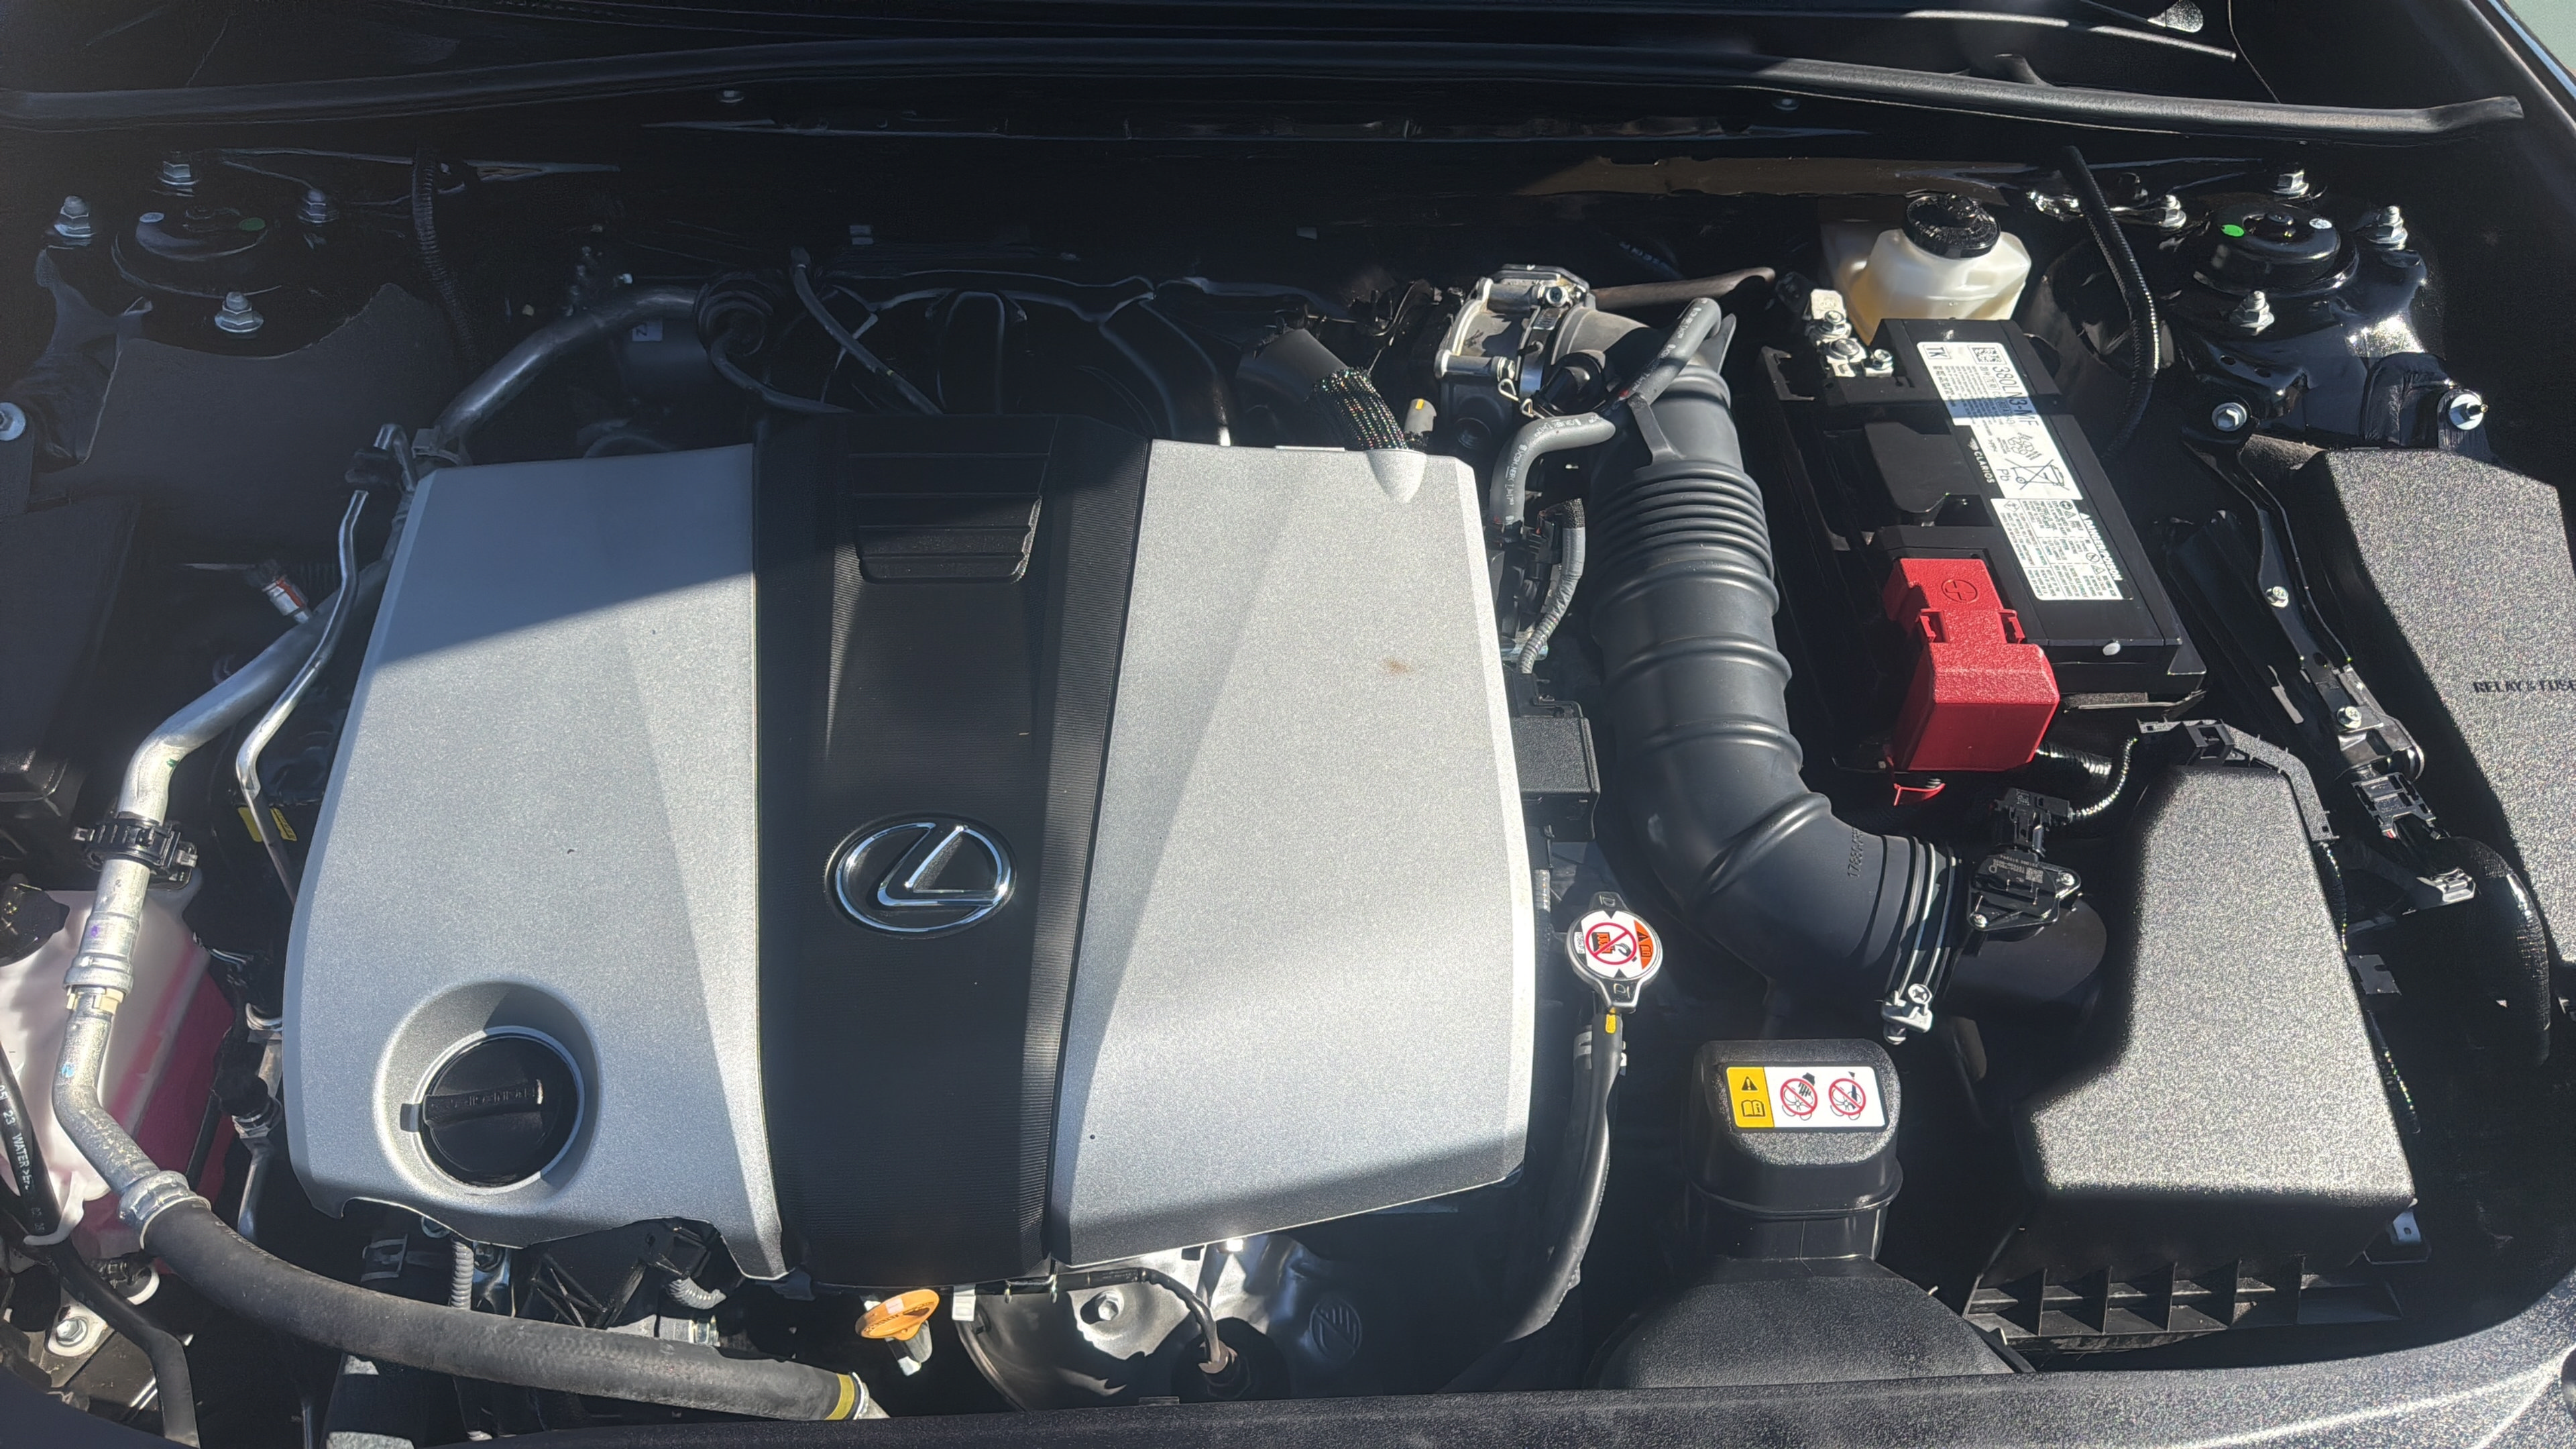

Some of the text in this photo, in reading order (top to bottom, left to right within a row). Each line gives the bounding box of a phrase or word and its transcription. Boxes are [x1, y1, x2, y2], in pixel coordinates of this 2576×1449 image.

[1926, 347, 1948, 358] TK
[1993, 366, 2039, 425] 380LN3-MF
[1974, 450, 1996, 484] CLARIOS
[1997, 468, 2011, 482] Pb
[2086, 521, 2123, 581] DANGER/POISON
[2473, 680, 2522, 693] RELAY
[3, 1111, 15, 1126] 23
[11, 1132, 30, 1169] WATER
